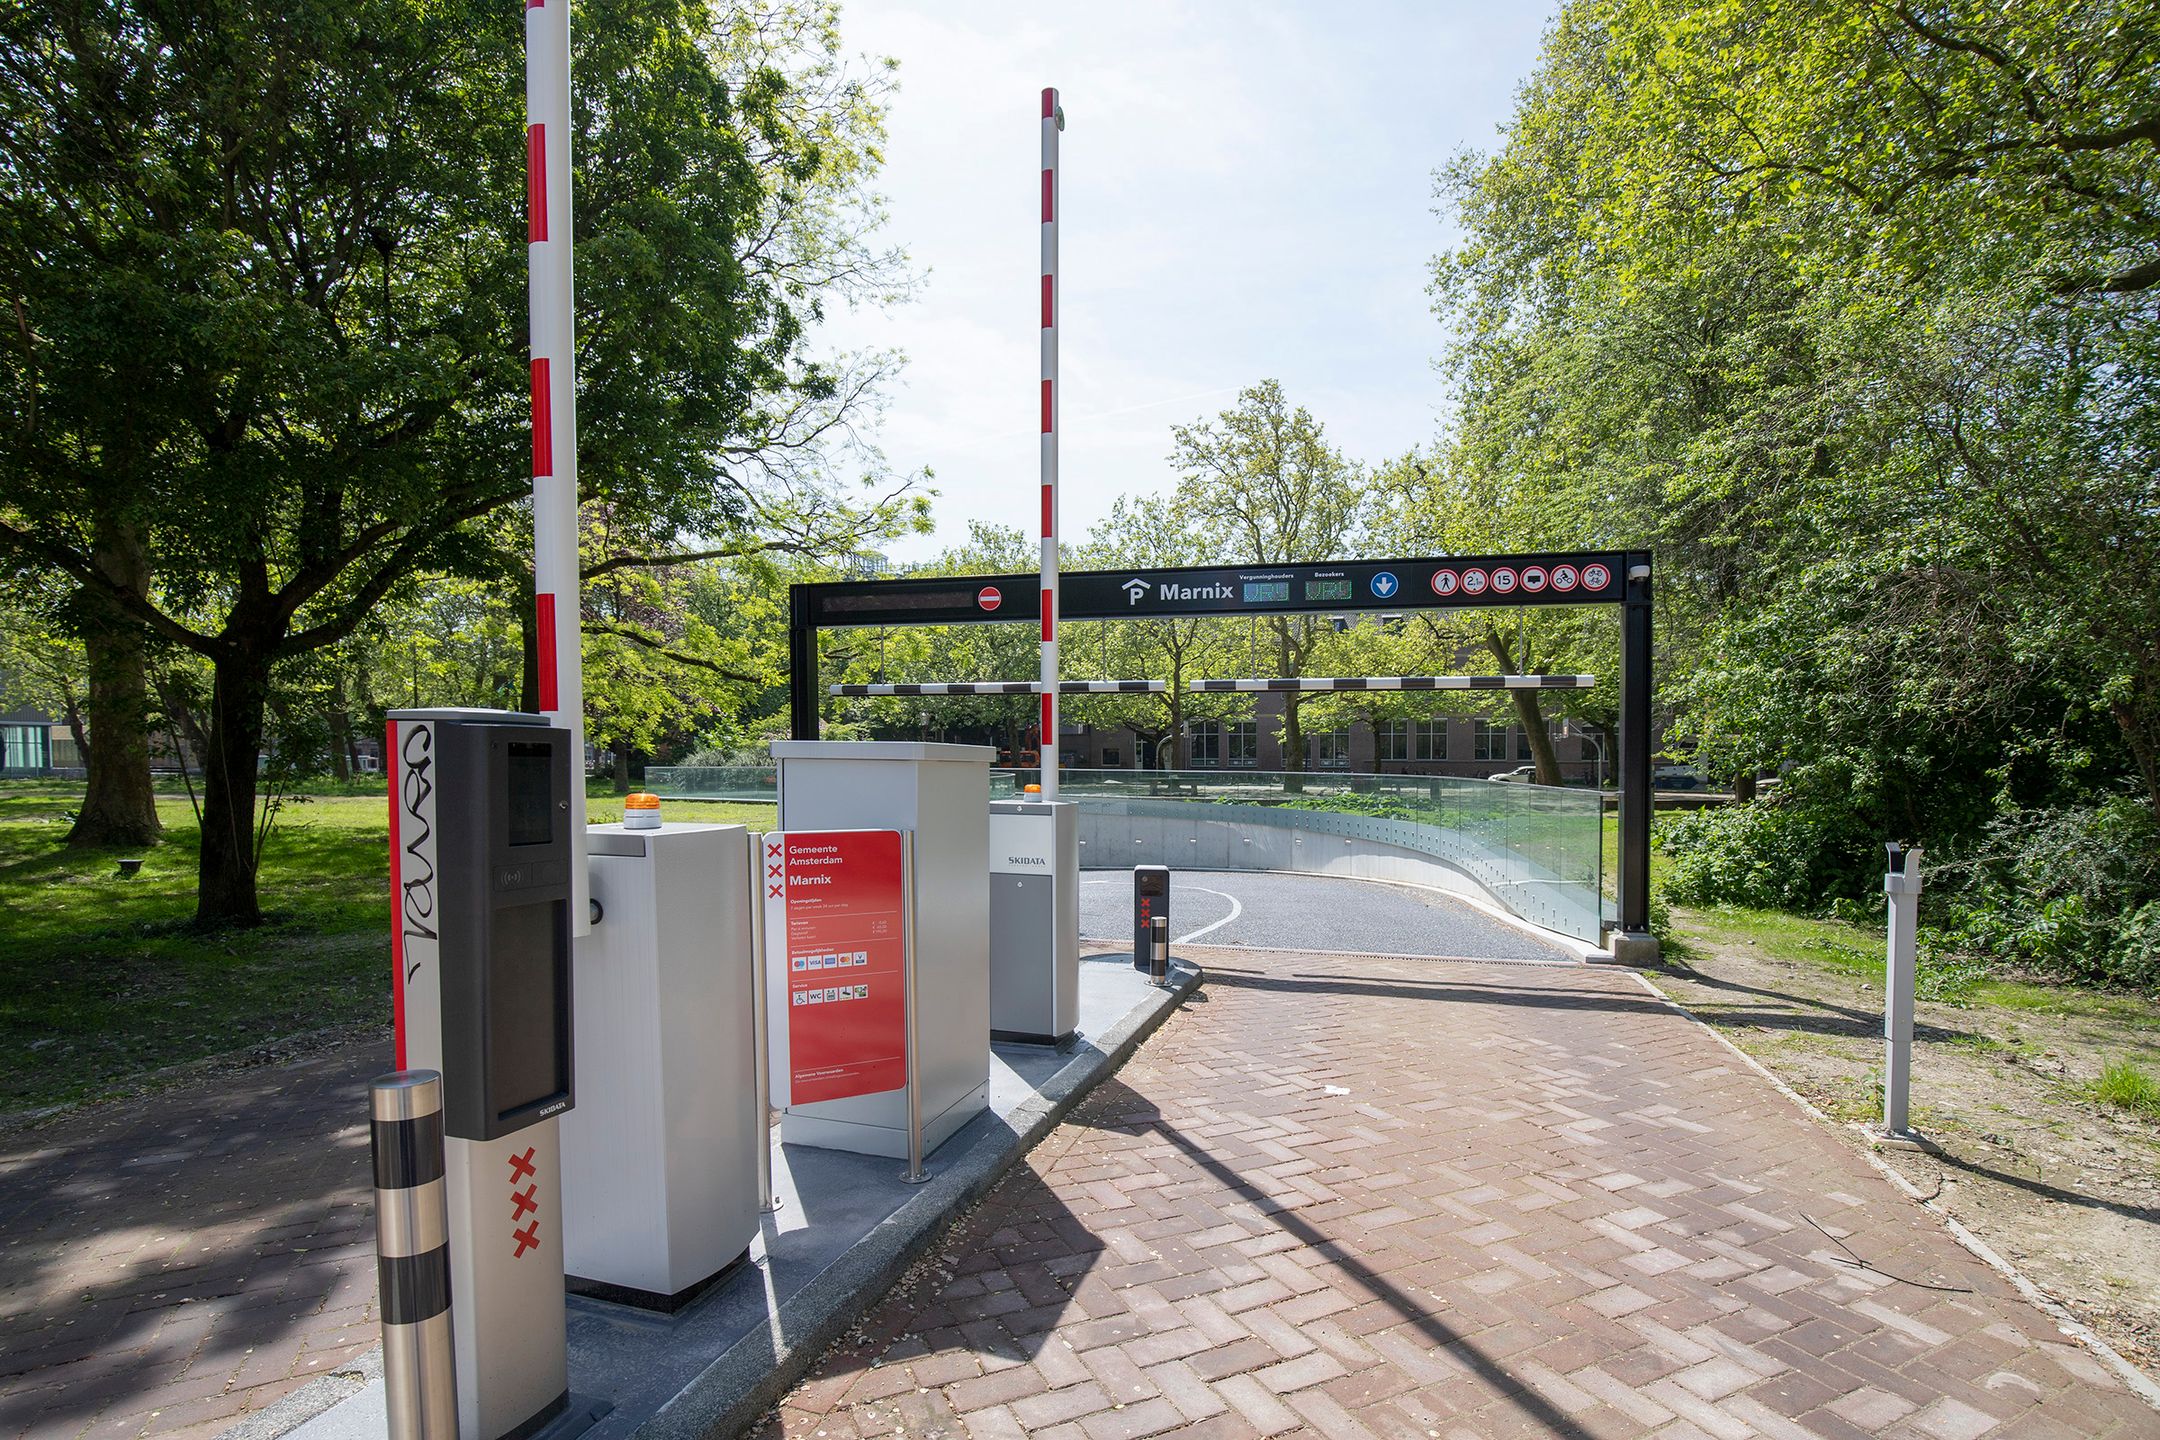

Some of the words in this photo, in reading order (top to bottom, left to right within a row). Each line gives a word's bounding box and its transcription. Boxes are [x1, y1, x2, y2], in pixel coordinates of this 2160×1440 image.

[1497, 575, 1511, 585] 15
[1160, 582, 1234, 600] Marnix
[789, 845, 838, 854] Gemeente
[789, 856, 843, 866] Amsterdam
[1008, 856, 1046, 865] SKIDATA
[789, 874, 832, 886] Marnix
[540, 1101, 566, 1117] SKIDATA
